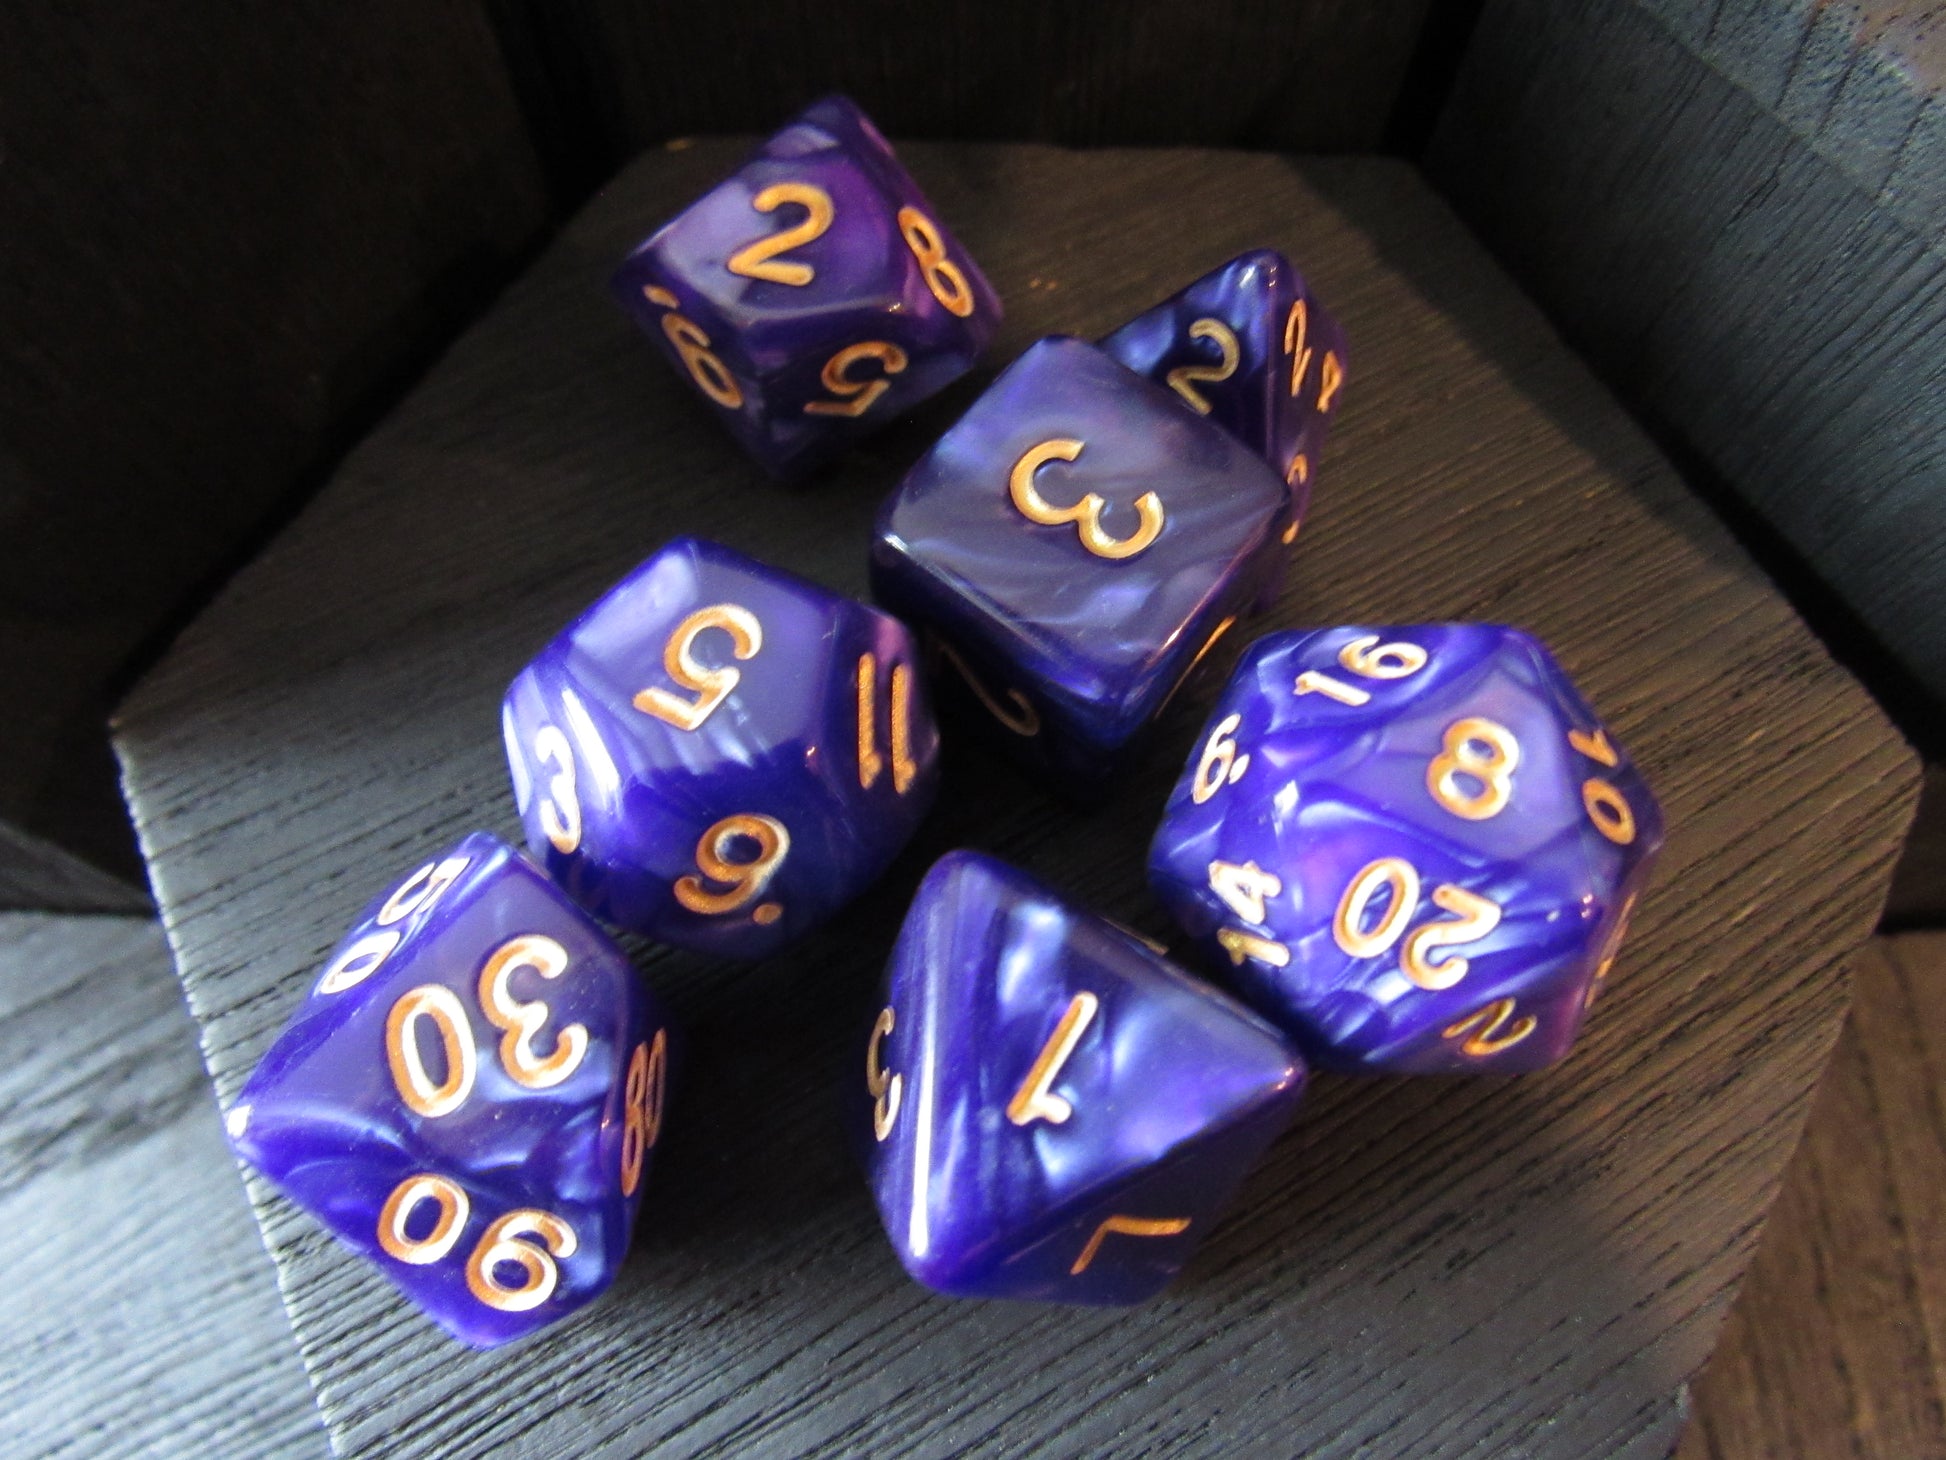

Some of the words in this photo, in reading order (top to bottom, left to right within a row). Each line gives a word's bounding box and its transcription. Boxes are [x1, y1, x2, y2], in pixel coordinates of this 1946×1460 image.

[726, 182, 835, 287] 2
[898, 205, 975, 317] 8
[803, 340, 909, 418] 5
[1167, 318, 1241, 416] 2
[1284, 298, 1312, 398] 2
[1010, 437, 1165, 560] 3
[633, 602, 764, 732] 5
[857, 651, 918, 795] 11
[1294, 634, 1428, 707] 16
[534, 724, 582, 855] 3
[1426, 717, 1520, 821] 8
[1568, 729, 1636, 846] 10
[1208, 859, 1291, 969] 14
[1332, 857, 1502, 992] 20
[385, 933, 589, 1119] 30
[867, 1006, 902, 1142] 3
[1006, 991, 1099, 1127] 1
[1441, 996, 1538, 1057] 2
[620, 1026, 668, 1198] 80
